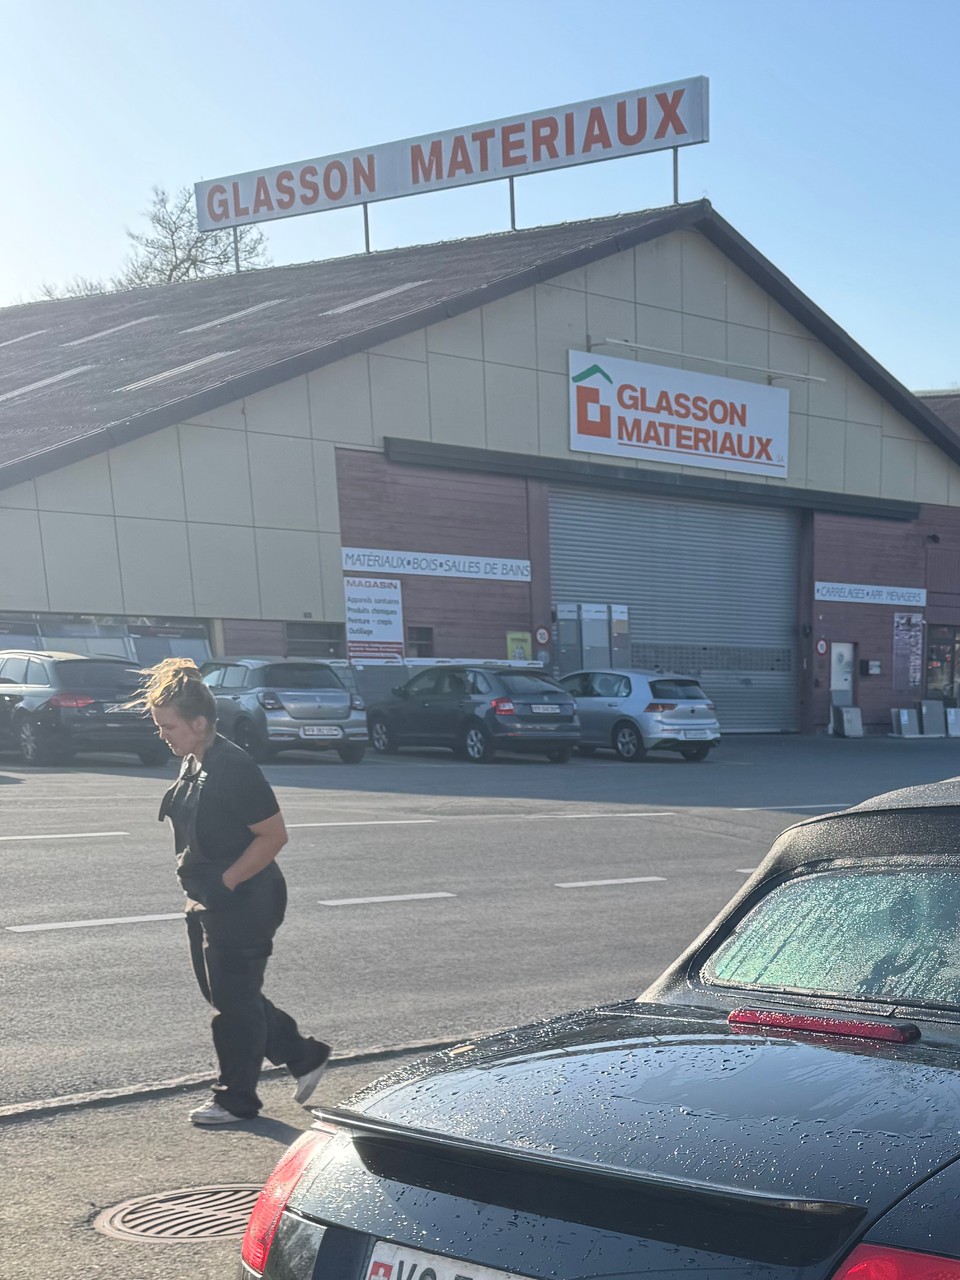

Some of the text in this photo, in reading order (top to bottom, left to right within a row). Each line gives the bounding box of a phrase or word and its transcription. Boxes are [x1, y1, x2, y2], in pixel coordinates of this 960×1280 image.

[207, 88, 688, 222] GLASSON MATERIAUX
[617, 384, 747, 427] GLASSON
[617, 415, 773, 461] MATERIAUX
[346, 580, 398, 589] MAGASIN
[444, 559, 481, 574] SALLES
[484, 562, 498, 575] DE
[502, 563, 531, 577] BAINS
